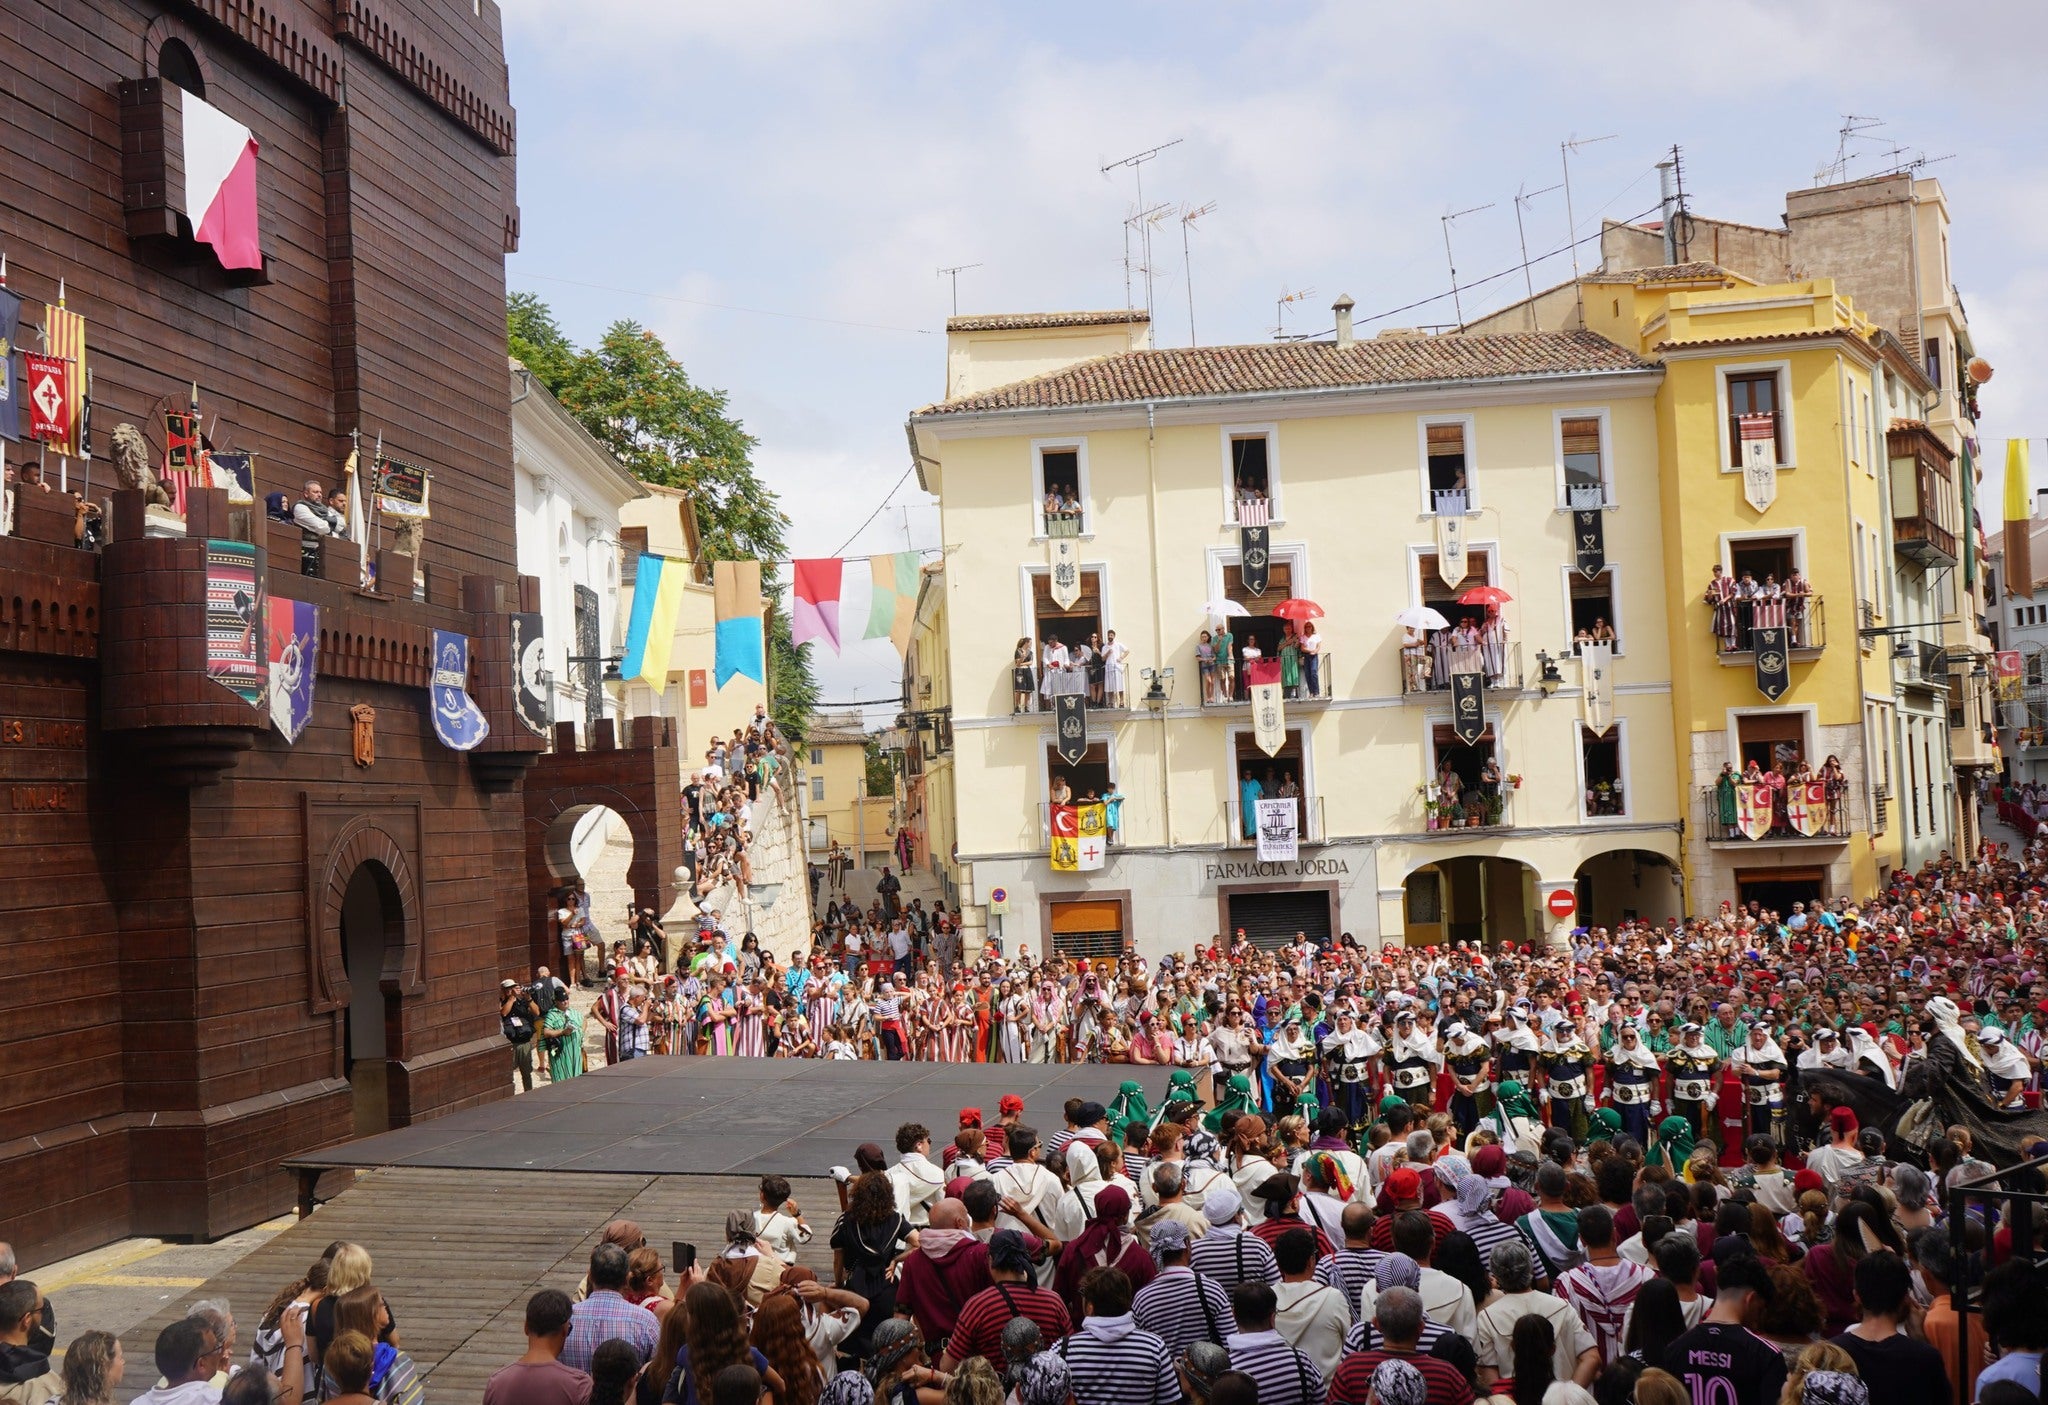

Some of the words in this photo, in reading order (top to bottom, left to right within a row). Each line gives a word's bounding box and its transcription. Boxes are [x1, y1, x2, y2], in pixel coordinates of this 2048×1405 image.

[2, 720, 24, 743] ES
[11, 786, 68, 810] LINAJE
[1206, 861, 1287, 880] FARMACIA
[1295, 859, 1349, 875] JORDA
[1688, 1349, 1732, 1369] MESSI
[1683, 1373, 1738, 1405] 10
